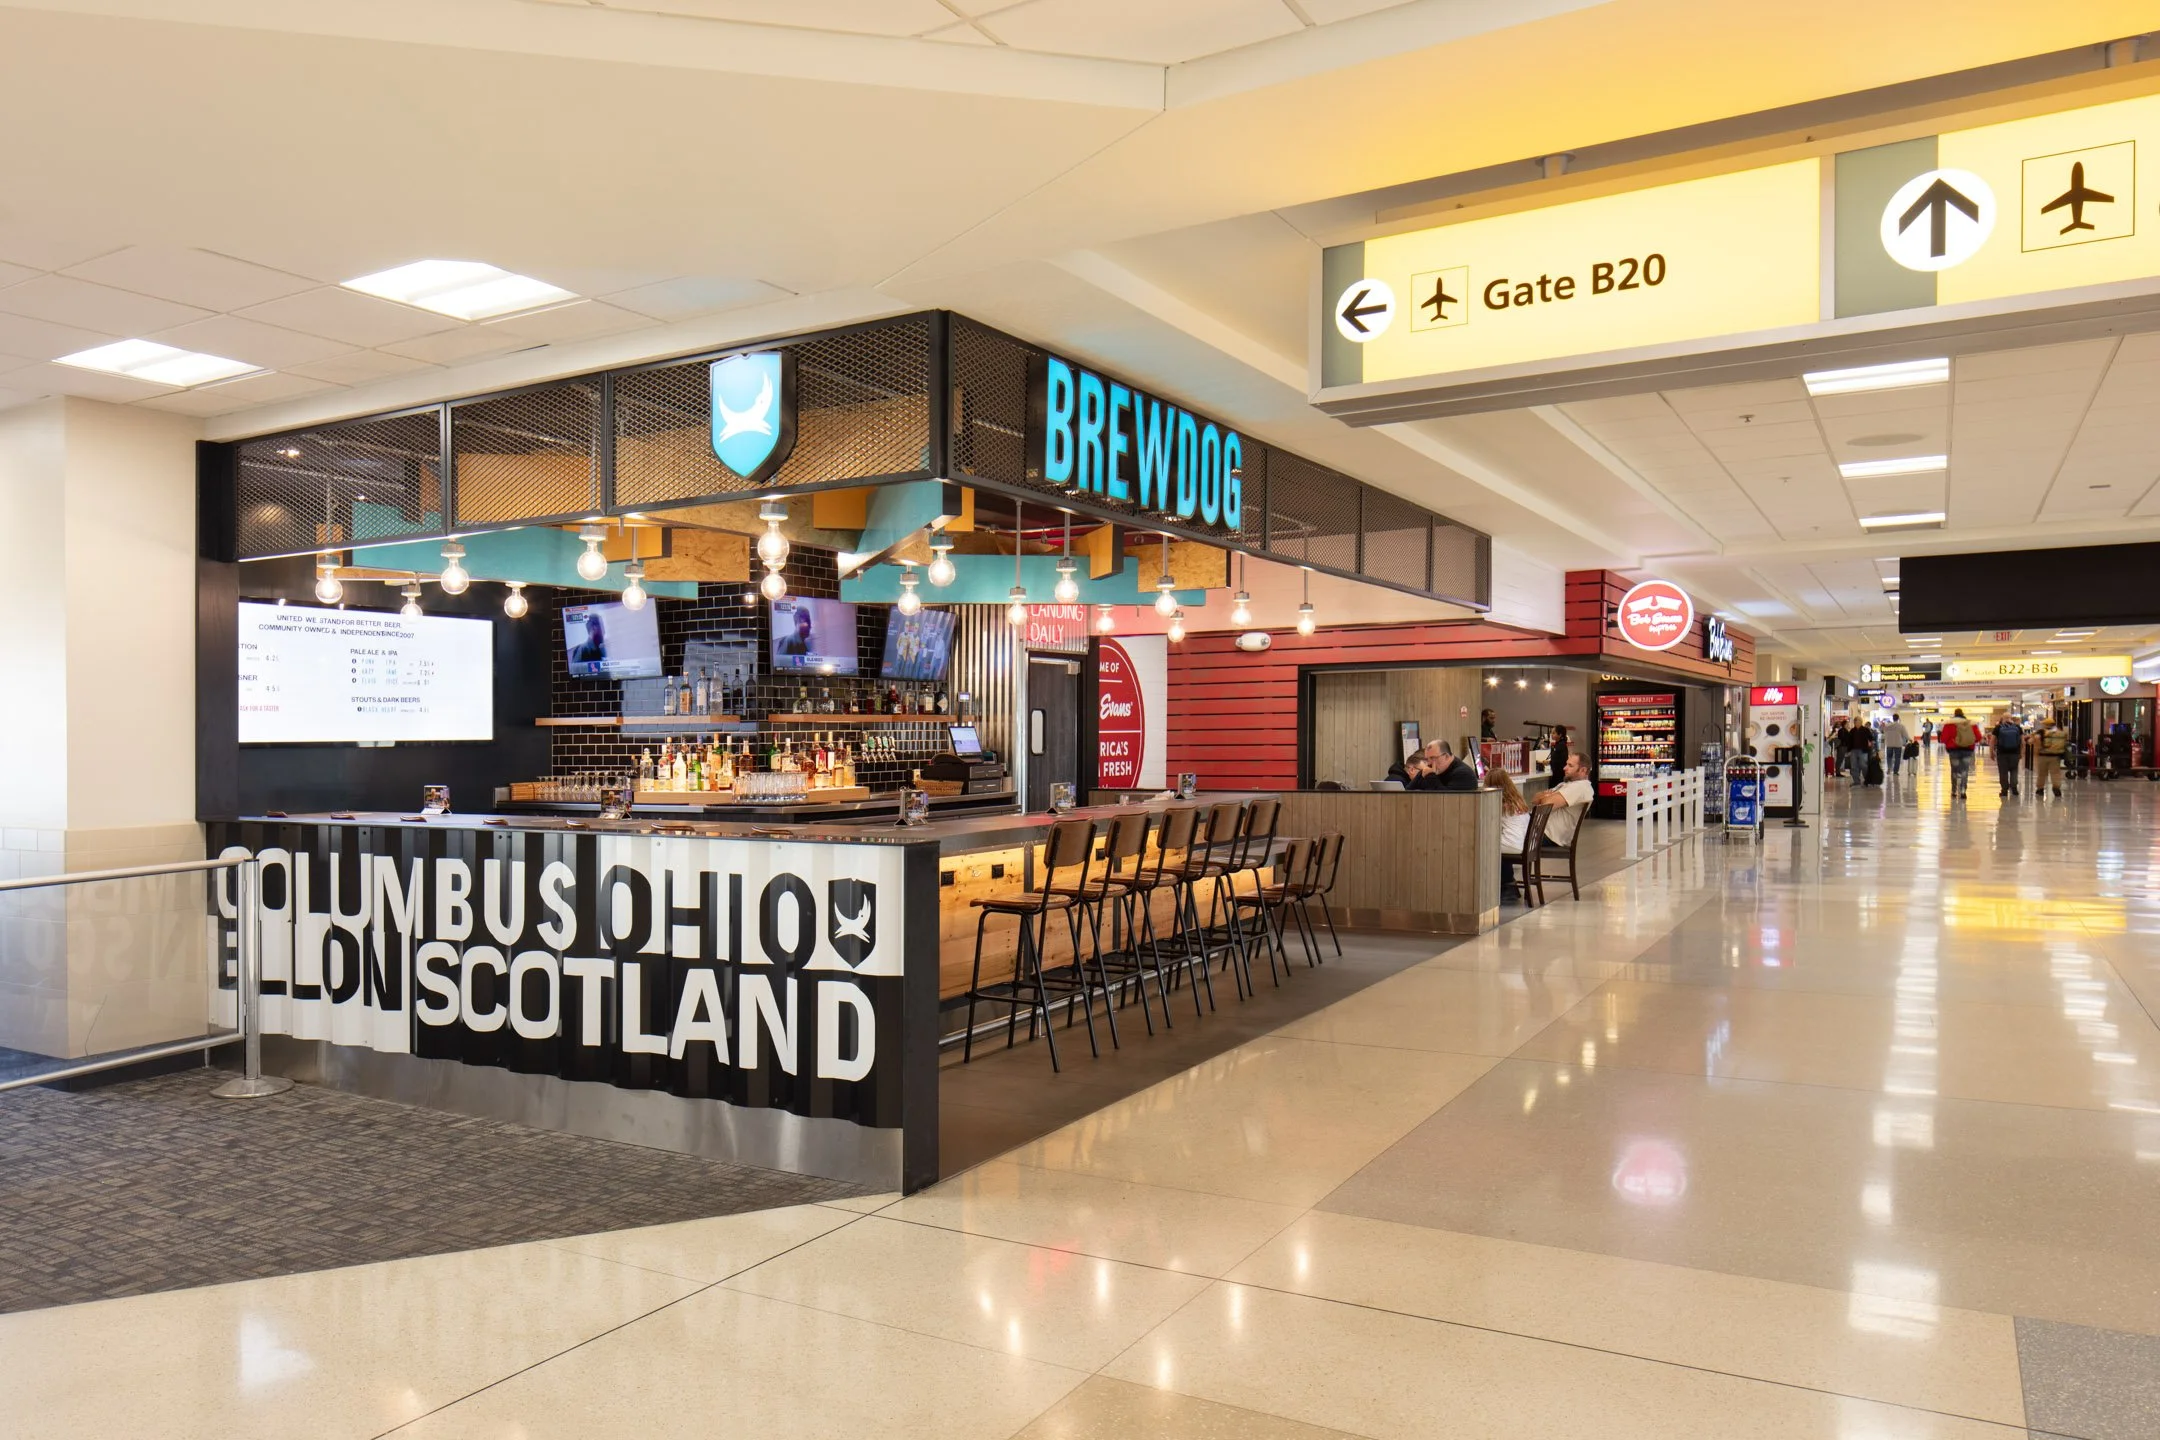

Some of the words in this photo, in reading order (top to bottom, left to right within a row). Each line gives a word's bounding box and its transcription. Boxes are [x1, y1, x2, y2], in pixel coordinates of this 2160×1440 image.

[1483, 274, 1575, 310] Gate
[1592, 253, 1666, 295] B20
[1045, 356, 1242, 531] BREWDOG
[319, 617, 341, 625] STAND
[1031, 605, 1084, 622] LANDING
[258, 624, 302, 632] COMMUNITY
[304, 626, 330, 634] OWNED
[340, 629, 383, 637] INDEPENDENT
[382, 630, 400, 638] SINCE
[1030, 622, 1064, 644] DAILY
[1995, 631, 2011, 642] EXIT
[1110, 662, 1120, 673] OF
[1998, 663, 2059, 675] B22-B36
[1763, 687, 1784, 704] illy
[1100, 693, 1132, 720] Evans
[1099, 741, 1129, 757] RICA'S
[1103, 760, 1132, 777] FRESH
[217, 846, 578, 951] COLUMBUS
[600, 864, 816, 969] OHIO
[415, 941, 876, 1082] SCOTLAND
